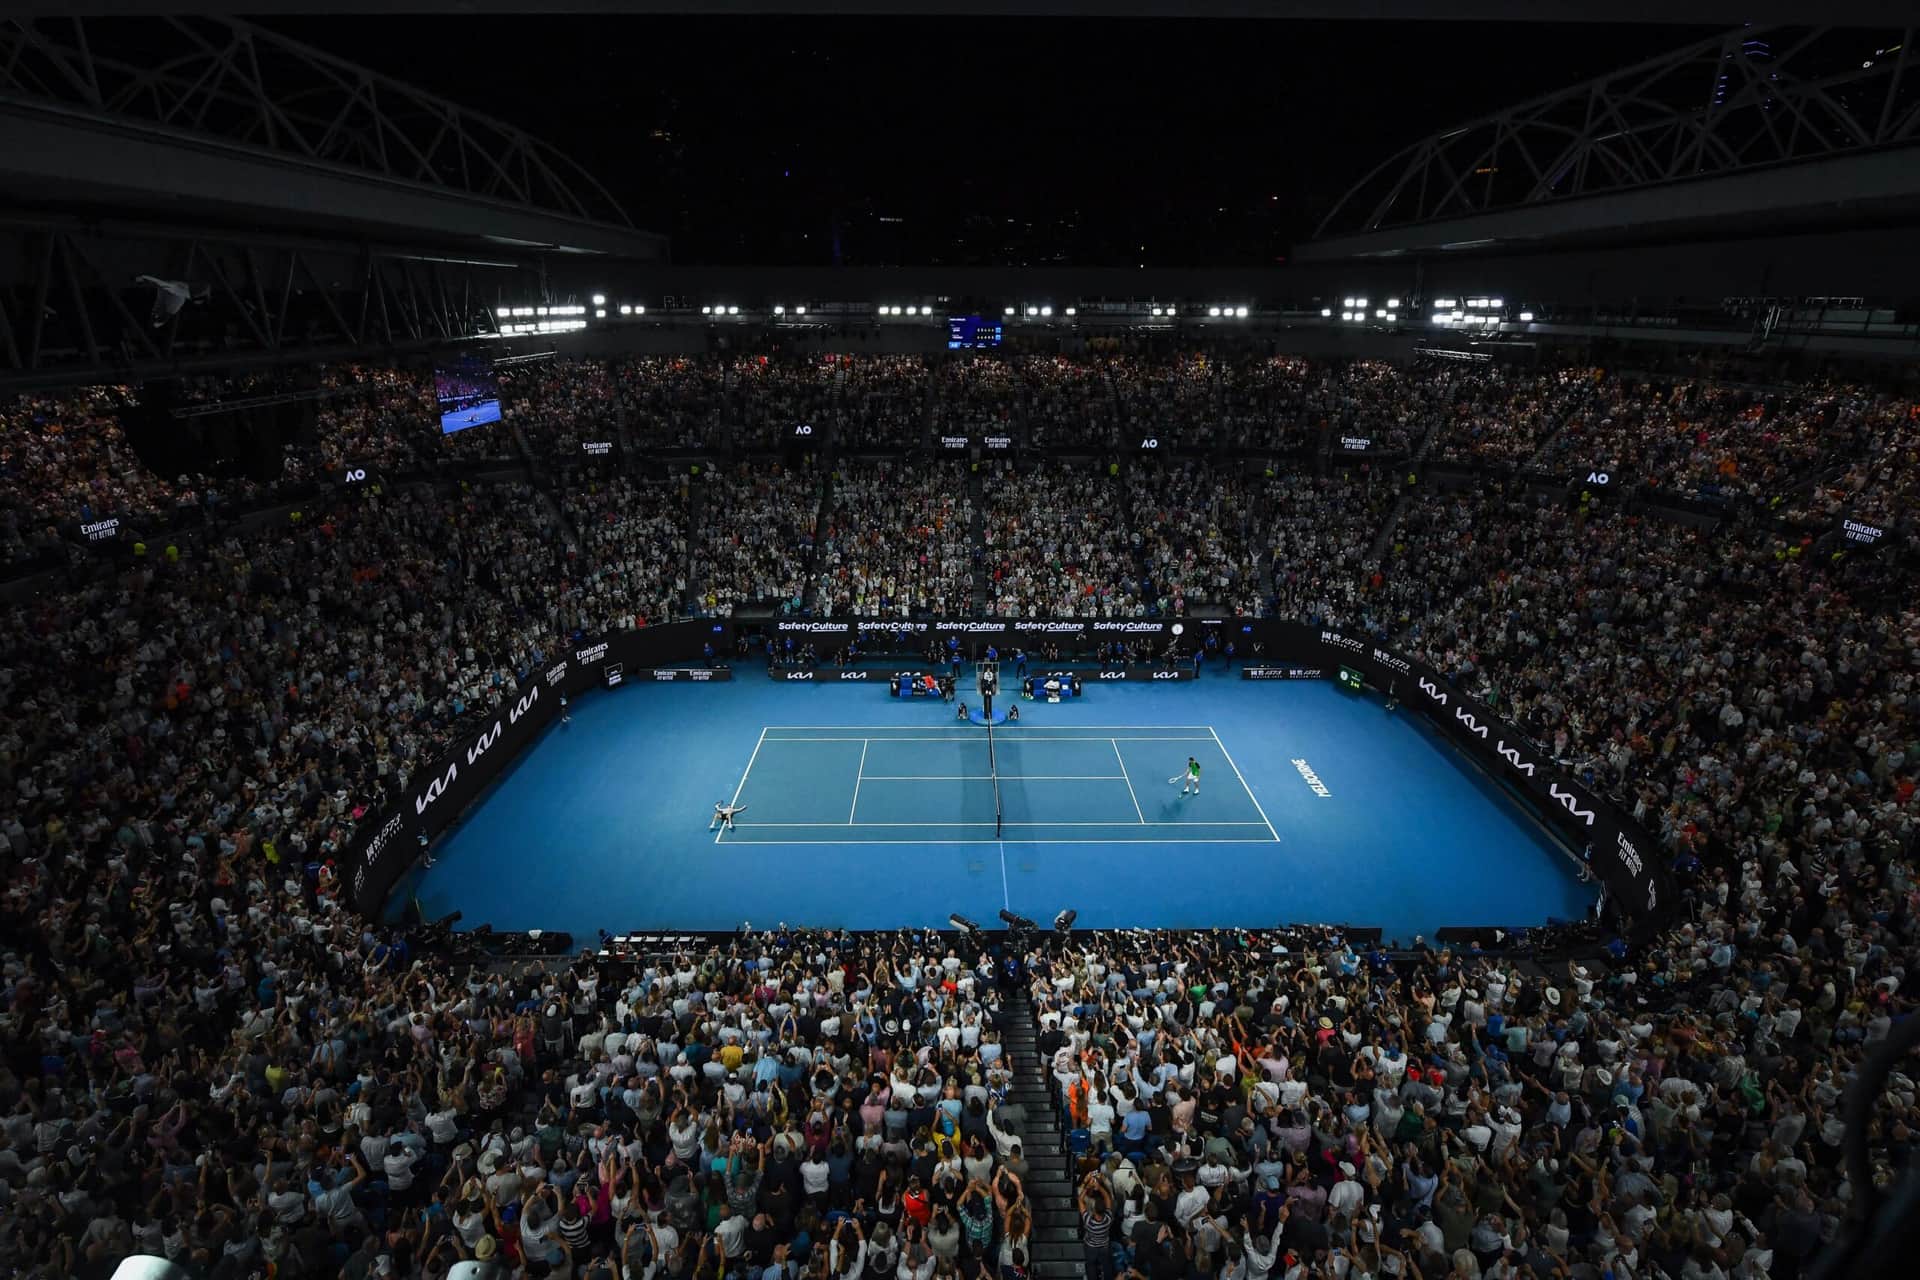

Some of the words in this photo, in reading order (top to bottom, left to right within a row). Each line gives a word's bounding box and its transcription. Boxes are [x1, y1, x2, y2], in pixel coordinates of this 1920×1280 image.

[795, 425, 812, 435] AO
[1141, 439, 1158, 448] AO
[345, 469, 366, 482] AO
[1587, 471, 1609, 484] AO
[80, 518, 120, 535] Emirates
[1843, 519, 1884, 538] Emirates
[778, 622, 848, 632] SafetyCulture
[936, 622, 1005, 632] SafetyCulture
[1015, 622, 1084, 632] SafetyCulture
[1093, 622, 1163, 632] SafetyCulture
[576, 642, 609, 661] Emirates
[1419, 676, 1447, 705] KIA
[510, 685, 538, 724] KIA
[1456, 706, 1488, 738] KIA
[467, 720, 502, 765] KIA
[1497, 740, 1535, 776] KIA
[416, 762, 458, 815] KIA
[1550, 783, 1595, 825] KIA
[1617, 831, 1643, 872] Emirates
